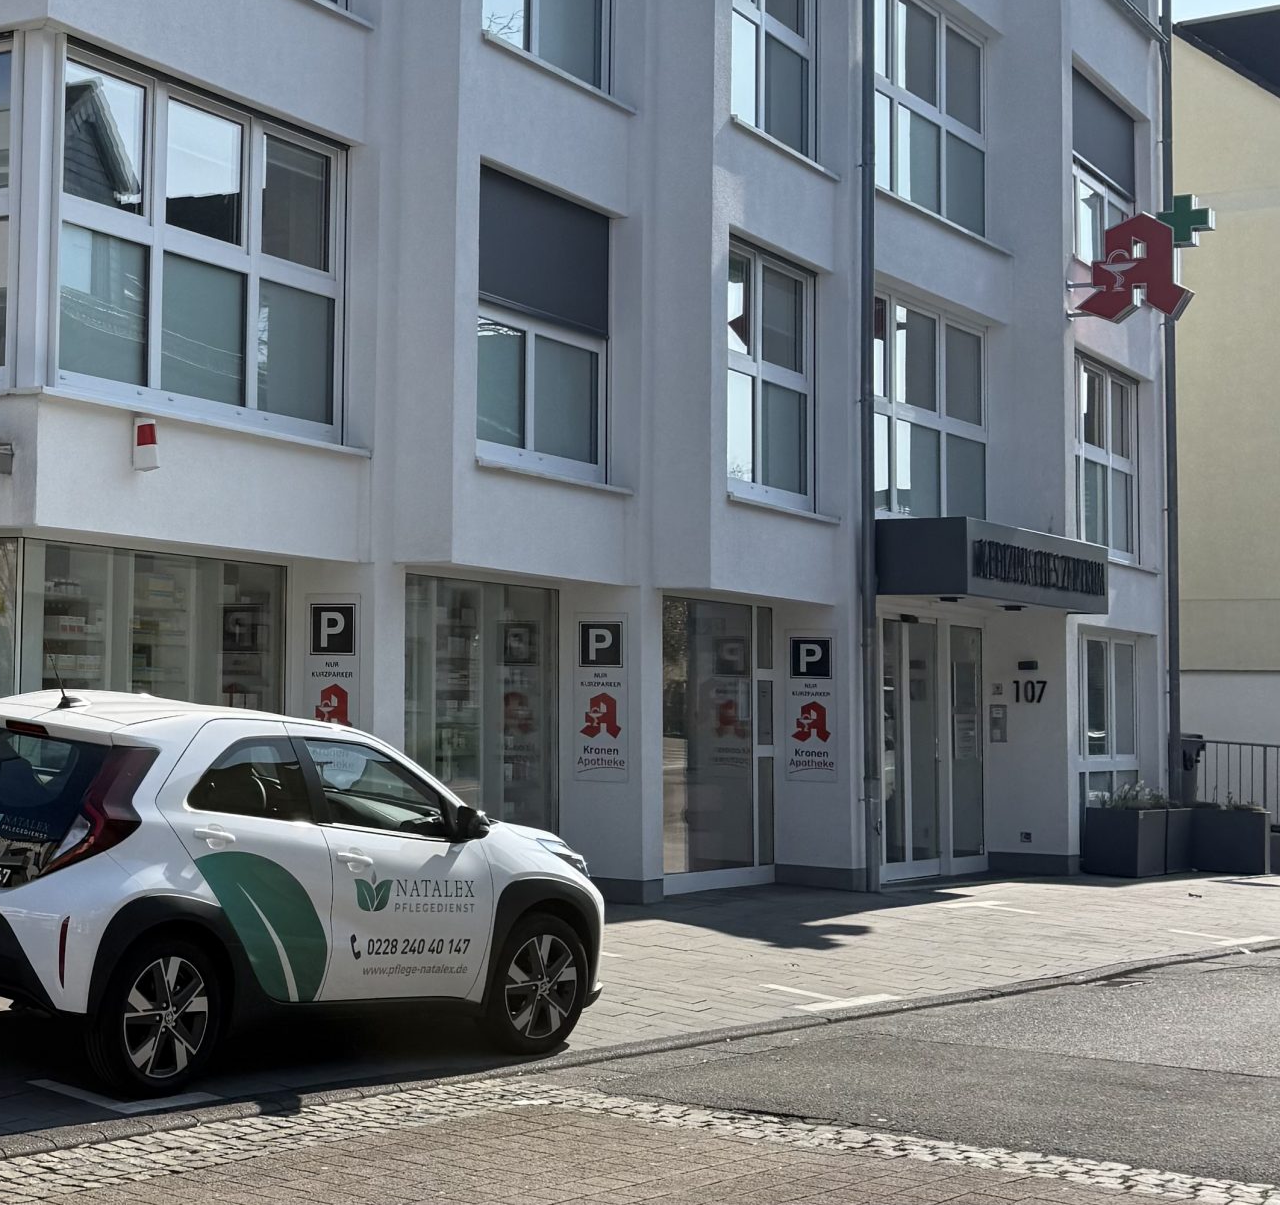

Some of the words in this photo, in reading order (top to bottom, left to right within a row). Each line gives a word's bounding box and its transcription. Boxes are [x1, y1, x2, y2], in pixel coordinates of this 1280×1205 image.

[320, 611, 345, 648] P
[589, 628, 613, 661] P
[799, 644, 823, 673] P
[1013, 680, 1048, 703] 107
[583, 745, 619, 756] Kronen
[794, 748, 829, 758] Kronen
[577, 757, 626, 768] Apotheke
[789, 758, 835, 769] Apotheke
[1, 824, 49, 839] PFLEGEDIENST
[4, 815, 49, 833] NATALEX
[396, 879, 476, 898] NATALEX
[394, 902, 476, 913] PFLEGEDIENST
[367, 938, 399, 956] 0228
[401, 938, 426, 955] 240
[427, 938, 445, 955] 40
[448, 938, 471, 955] 147
[362, 963, 468, 977] www.pflege-natalex.de
